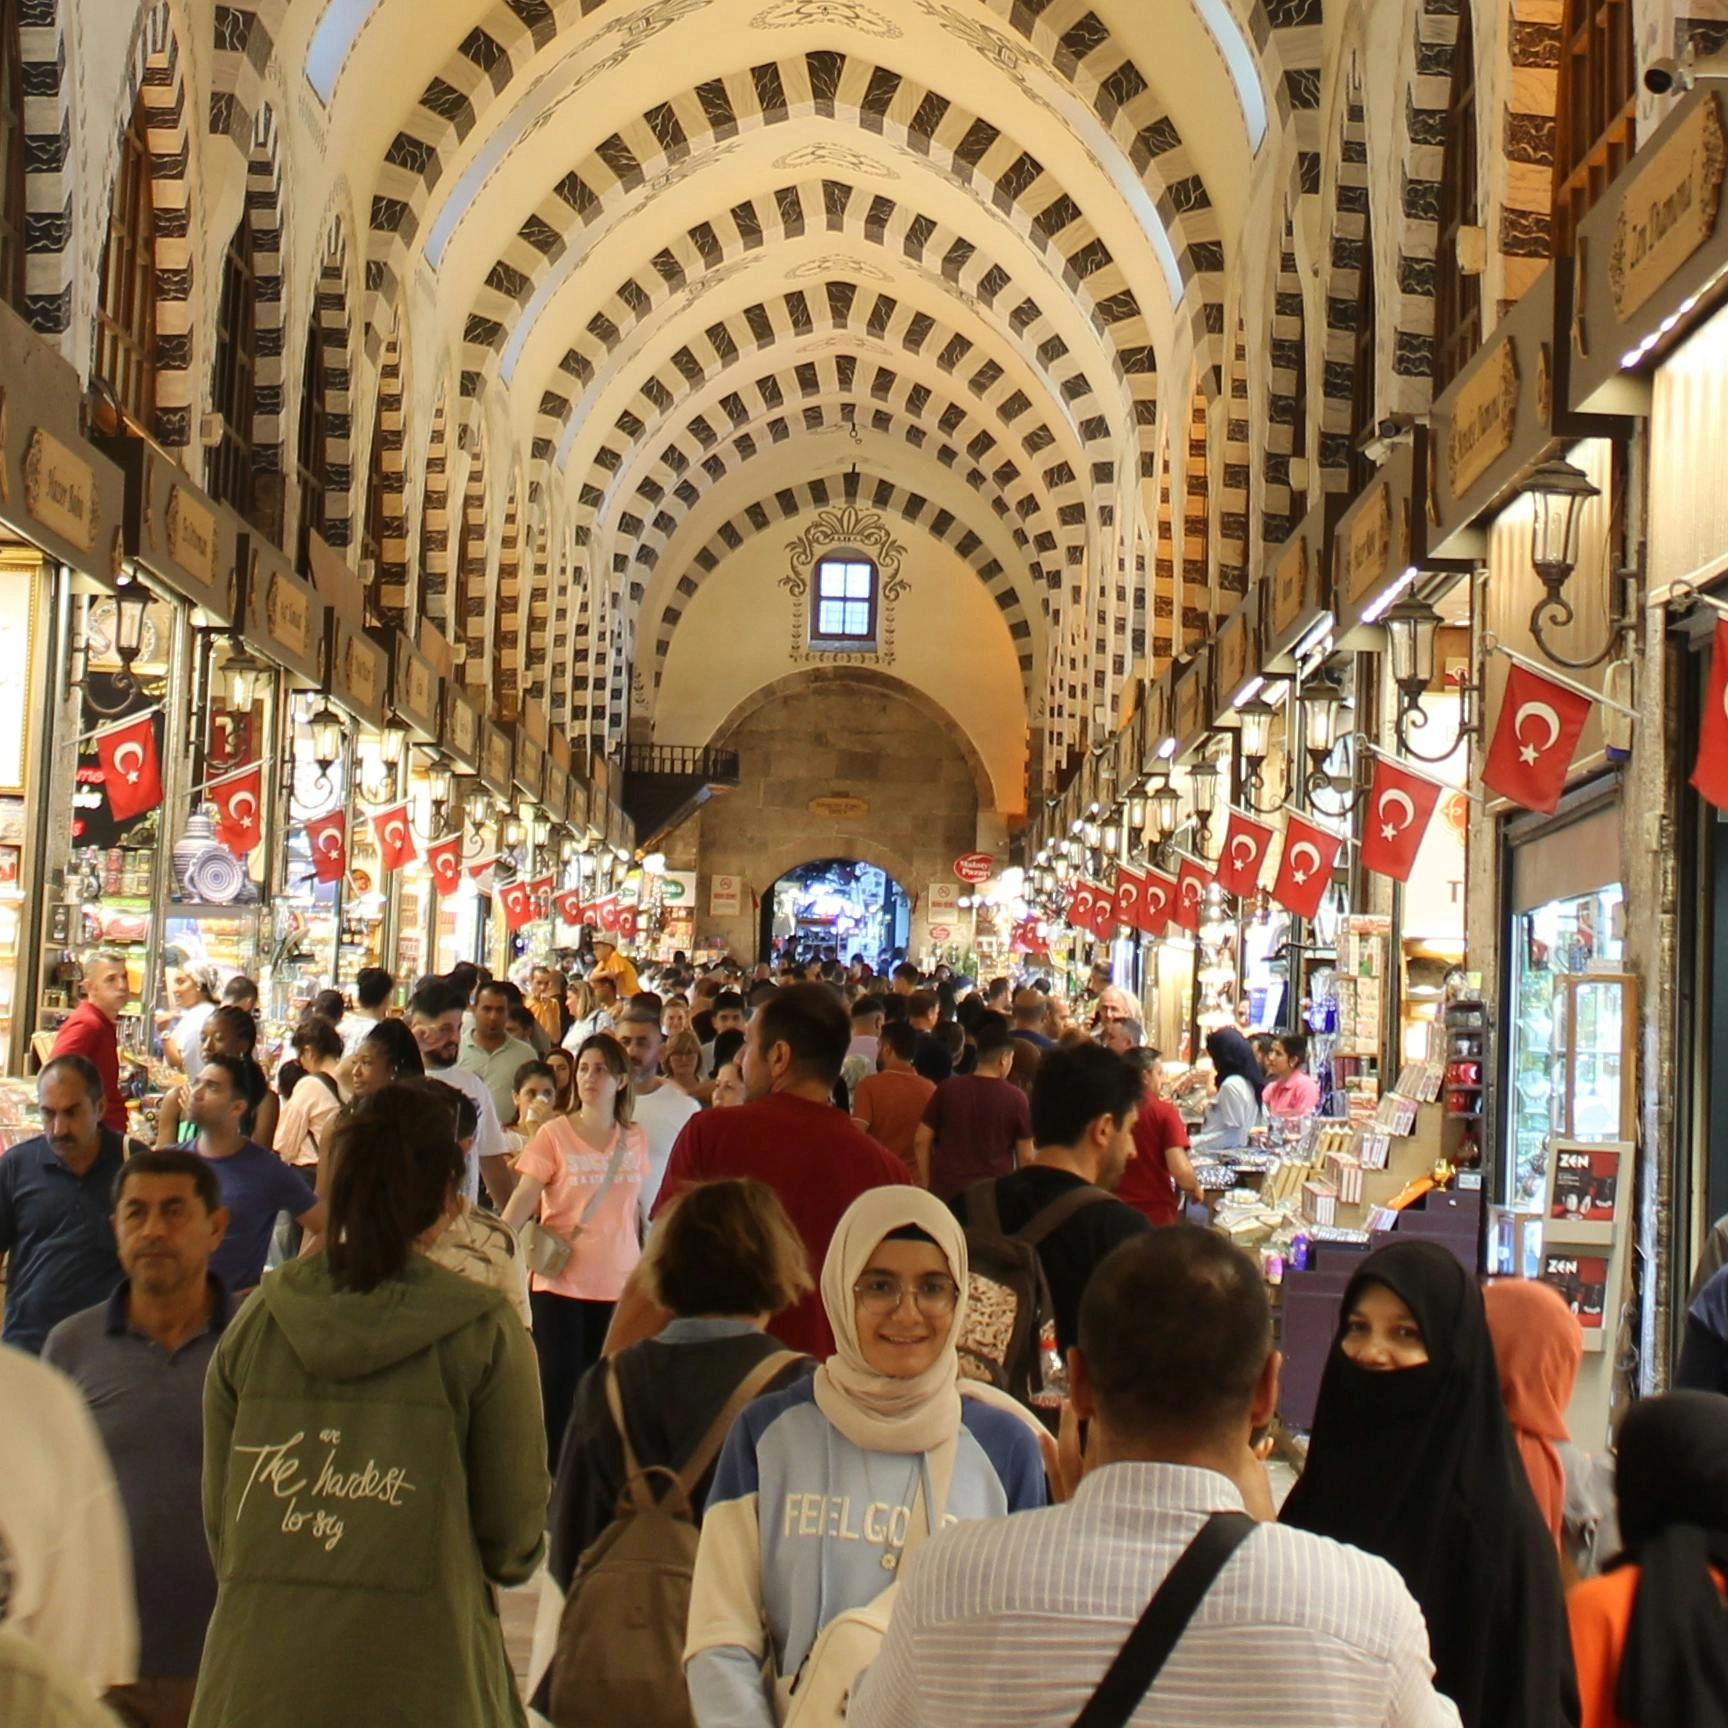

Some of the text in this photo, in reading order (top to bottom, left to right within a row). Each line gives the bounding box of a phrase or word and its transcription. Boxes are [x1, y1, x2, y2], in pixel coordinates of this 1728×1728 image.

[1559, 1153, 1590, 1169] ZEN
[1547, 1258, 1578, 1274] ZEN
[234, 1431, 417, 1522] The hardest
[784, 1492, 860, 1540] FEEL
